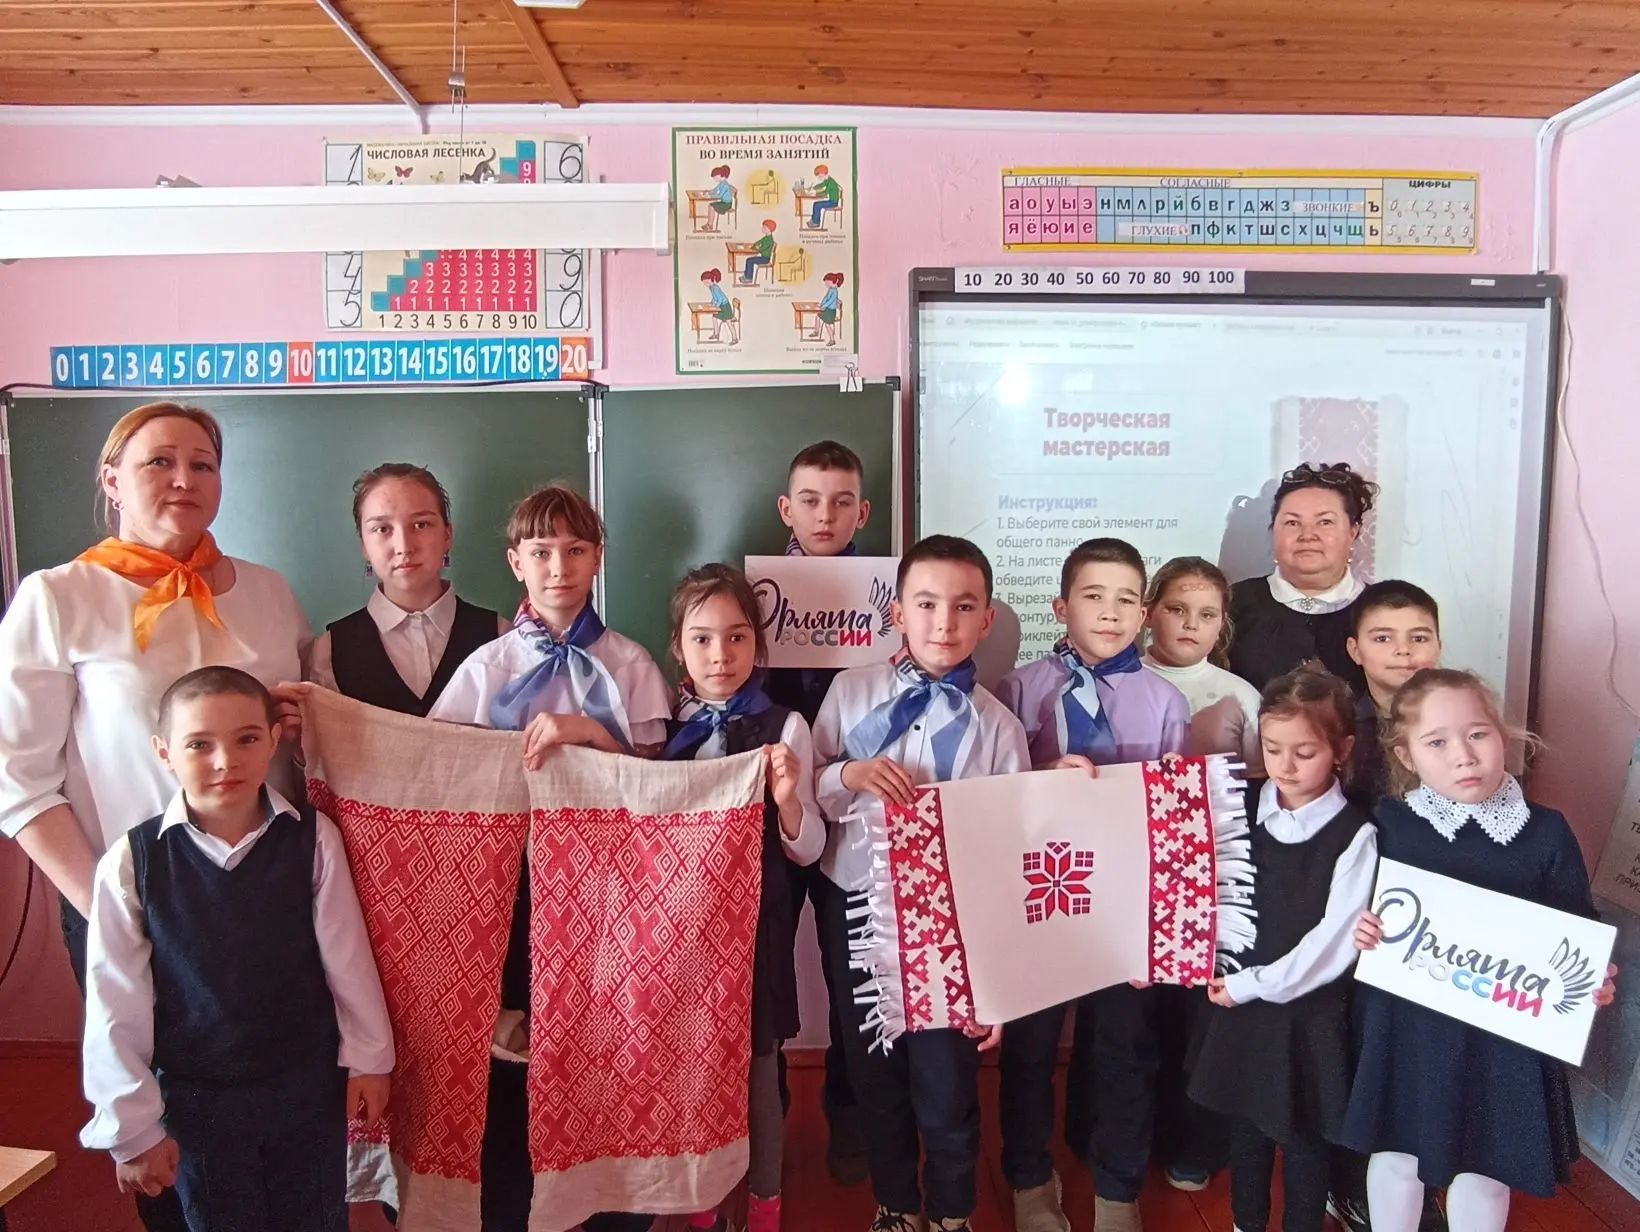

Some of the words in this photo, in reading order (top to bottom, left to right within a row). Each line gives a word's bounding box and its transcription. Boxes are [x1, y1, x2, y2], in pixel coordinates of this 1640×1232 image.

[686, 135, 776, 145] ПРАВИЛЬНАЯ
[780, 135, 842, 146] ПОСАДКА
[367, 149, 429, 160] ЧИСЛОВАЯ
[433, 148, 486, 158] ЛЕСЕНКА
[700, 150, 716, 159] ВО
[720, 150, 763, 159] ВРЕМЯ
[766, 148, 830, 159] ЗАНЯТИЙ
[523, 162, 532, 177] 9
[559, 144, 582, 180] 6
[1014, 176, 1072, 186] ГЛАСНЫЕ
[1160, 178, 1231, 188] СОГЛАСНЫЕ
[1409, 180, 1451, 189] ЦИФРЫ
[1303, 203, 1354, 213] ЗВОНКИЕ
[1131, 225, 1177, 236] ГЛУХИЕ
[560, 254, 582, 290] 9
[964, 273, 981, 286] 10
[994, 273, 1012, 286] 20
[1021, 273, 1039, 286] 30
[1047, 273, 1065, 285] 40
[1076, 272, 1094, 285] 50
[1102, 272, 1120, 285] 60
[1128, 272, 1146, 284] 70
[1153, 272, 1171, 284] 80
[1182, 271, 1200, 284] 90
[1208, 271, 1234, 284] 100
[340, 290, 361, 327] 5
[560, 291, 582, 328] 0
[379, 314, 385, 329] 1
[394, 314, 402, 329] 2
[410, 314, 419, 329] 3
[426, 314, 435, 329] 4
[443, 314, 451, 329] 5
[460, 314, 468, 329] 6
[477, 314, 484, 329] 7
[492, 314, 501, 329] 8
[508, 314, 517, 329] 9
[522, 314, 537, 329] 10
[56, 353, 69, 382] 0
[79, 352, 90, 381] 1
[102, 352, 115, 380] 2
[126, 352, 139, 380] 3
[150, 351, 164, 380] 4
[173, 351, 186, 379] 5
[197, 350, 211, 379] 6
[221, 350, 235, 378] 7
[245, 349, 259, 378] 8
[269, 349, 283, 378] 9
[290, 348, 313, 377] 10
[317, 348, 337, 377] 11
[344, 348, 366, 376] 12
[371, 347, 393, 376] 13
[398, 347, 422, 375] 14
[426, 346, 448, 375] 15
[452, 345, 477, 374] 16
[480, 345, 503, 374] 17
[507, 345, 531, 374] 18
[535, 344, 559, 374] 19
[562, 344, 587, 373] 20
[1043, 407, 1171, 432] Творческая
[1043, 440, 1171, 461] мастерская
[998, 495, 1098, 512] Инструкция:
[1008, 516, 1069, 532] Выберите
[1072, 515, 1101, 529] свой
[1103, 518, 1153, 529] элемент
[1156, 518, 1178, 531] для
[996, 536, 1043, 549] общего
[1009, 555, 1024, 567] На
[1028, 557, 1061, 567] листе
[996, 573, 1053, 586] обведите
[752, 578, 873, 642] Орлята
[780, 630, 871, 646] РОССИИ
[1377, 887, 1550, 997] Орлята
[1408, 955, 1543, 1017] РОССИИ
